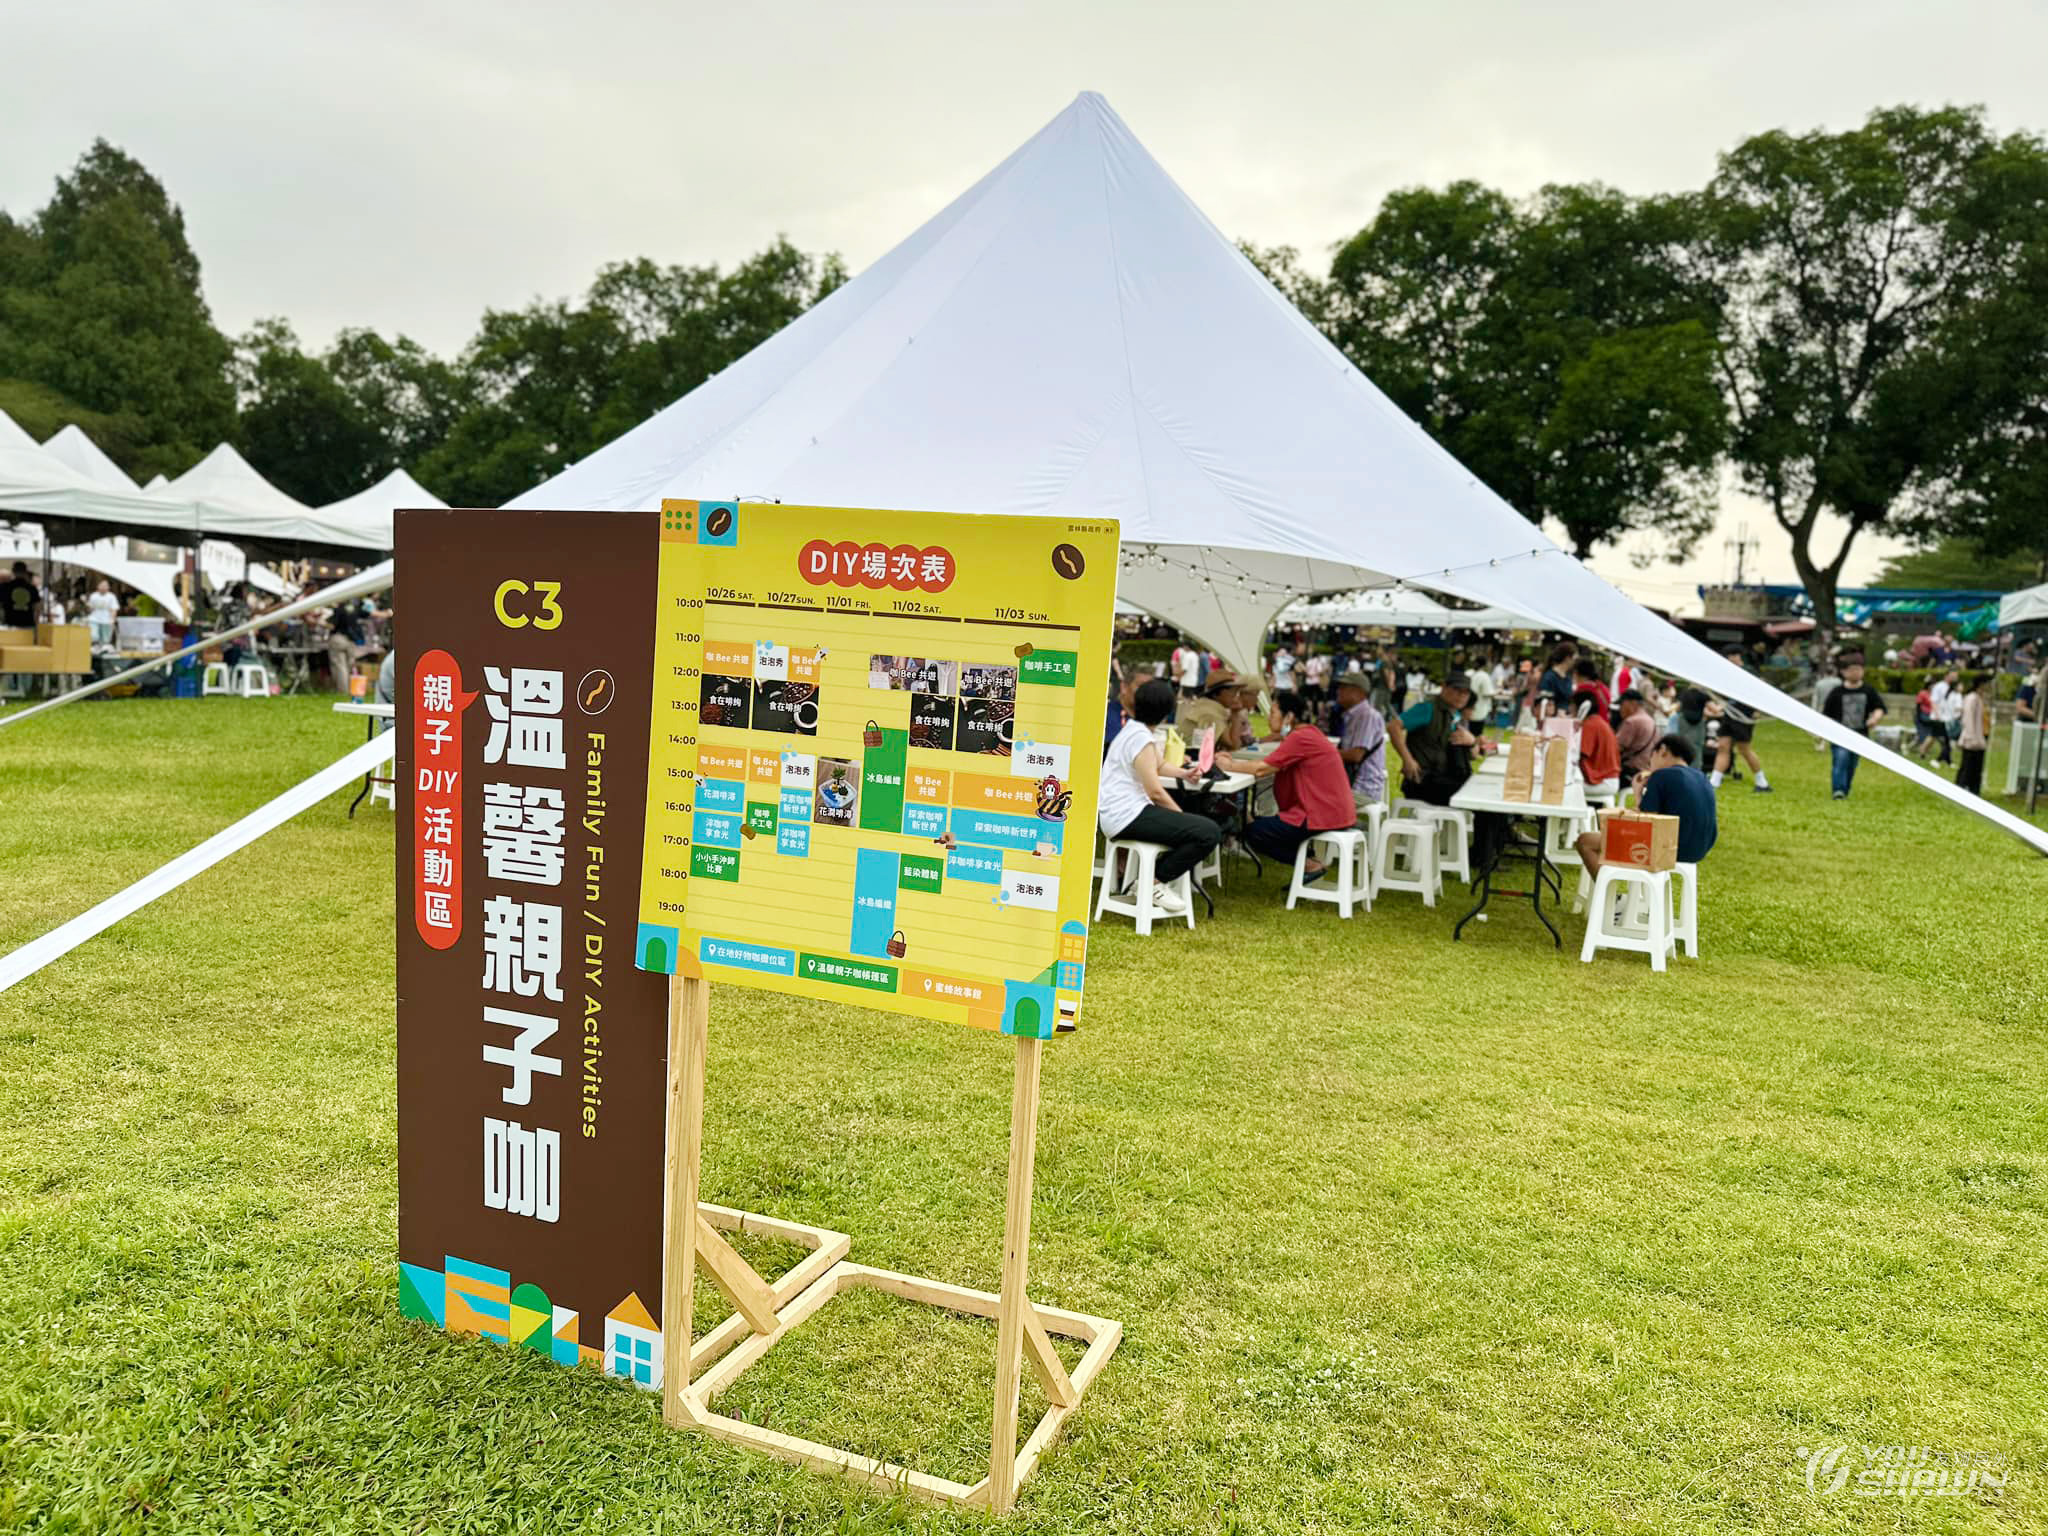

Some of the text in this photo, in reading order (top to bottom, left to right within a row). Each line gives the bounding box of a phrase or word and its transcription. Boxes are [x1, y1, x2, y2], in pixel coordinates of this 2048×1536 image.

[811, 550, 946, 584] DIY場次表
[707, 587, 754, 600] 10/26 SAT.
[767, 592, 815, 605] 10/27 SUN.
[493, 579, 564, 631] C3
[676, 598, 703, 609] 10:00
[826, 596, 871, 609] 11/01 FRI.
[892, 601, 942, 614] 11/02 SAT.
[994, 607, 1050, 622] 11/03 SUN.
[676, 632, 700, 643] 11:00
[715, 653, 731, 662] Bee
[759, 656, 783, 667] 泡泡秀
[673, 666, 700, 678] 12:00
[1024, 661, 1071, 674] 咖啡手工皂
[889, 668, 936, 681] 咖 Bee 共遊
[975, 675, 992, 685] Bee
[671, 701, 698, 712] 13:00
[669, 734, 696, 745] 14:00
[710, 756, 725, 766] Bee
[762, 757, 778, 767] Bee
[1026, 754, 1054, 766] 泡泡秀
[667, 768, 694, 779] 15:00
[786, 764, 810, 776] 泡泡秀
[925, 777, 942, 787] Bee
[996, 790, 1012, 799] Bee
[665, 801, 692, 813] 16:00
[912, 820, 938, 832] 新世界
[663, 834, 689, 846] 17:00
[660, 867, 688, 880] 18:00
[1016, 882, 1044, 896] 泡泡秀
[658, 901, 685, 913] 19:00
[582, 732, 607, 1139] Family Fun / DIY Activities
[482, 666, 568, 1224] 溫馨親子咖
